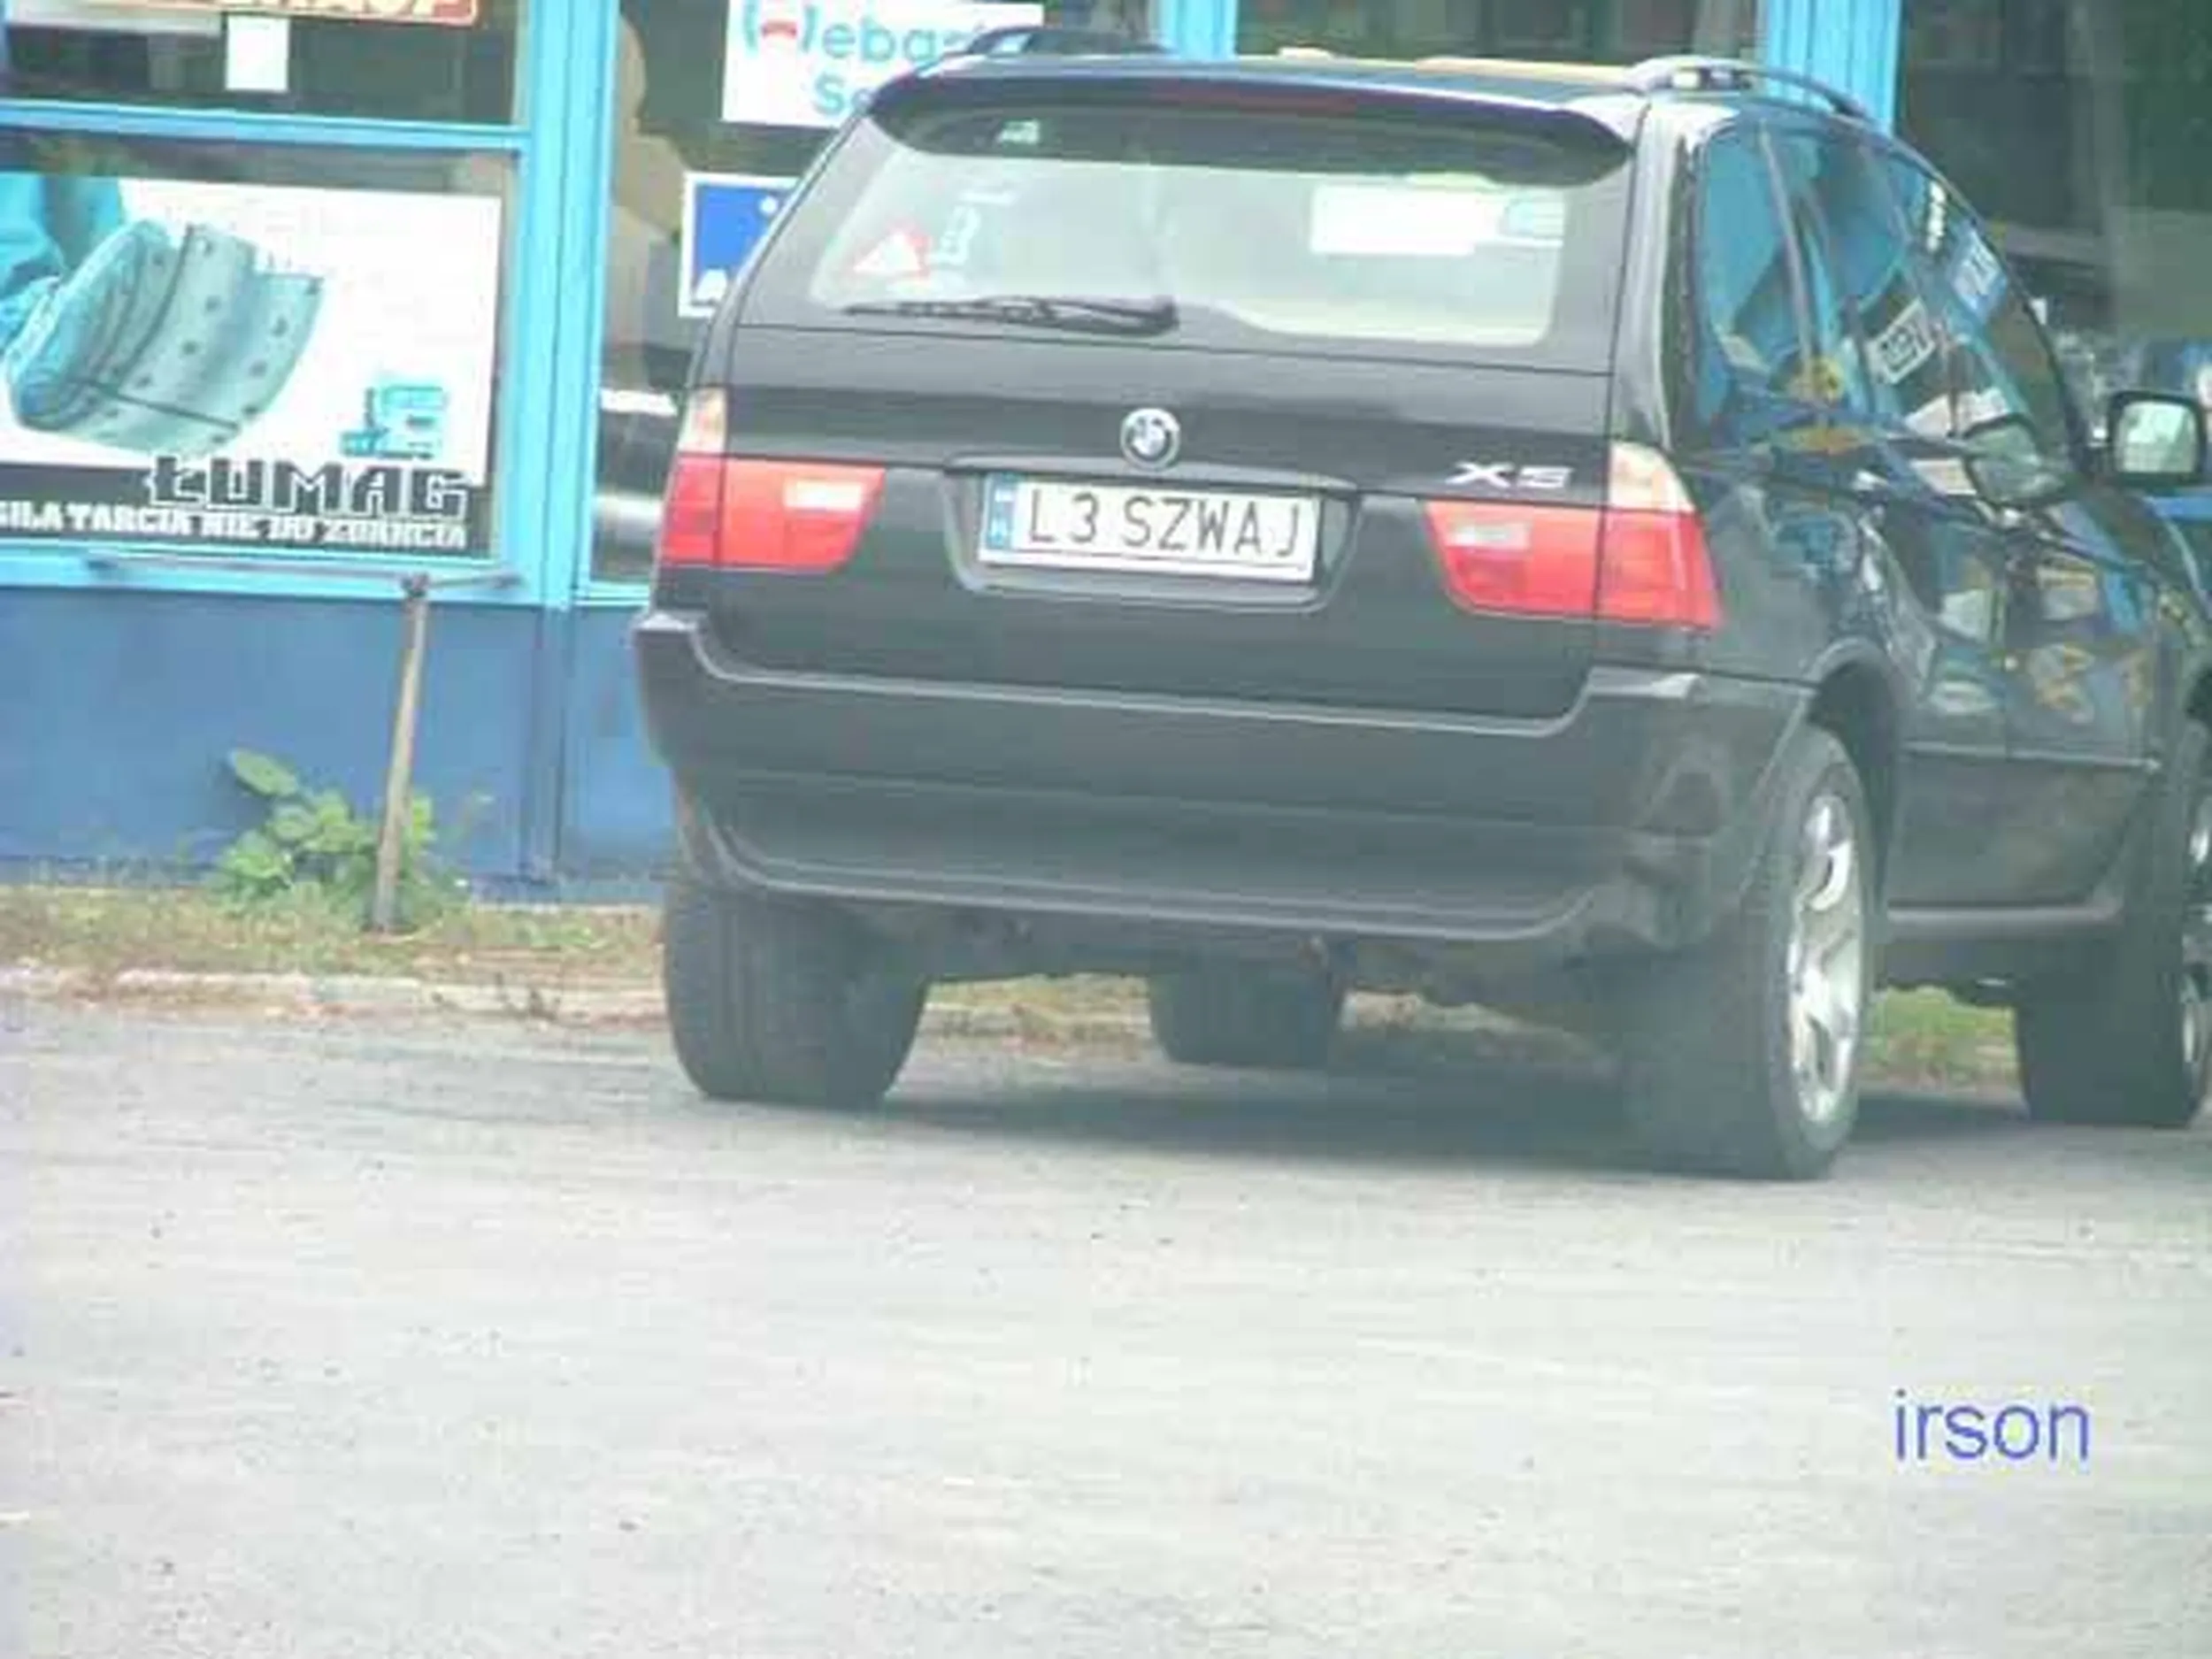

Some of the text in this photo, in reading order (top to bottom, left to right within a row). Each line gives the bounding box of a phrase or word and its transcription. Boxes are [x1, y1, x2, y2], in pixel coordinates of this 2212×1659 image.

[1445, 461, 1574, 488] X5
[1029, 488, 1300, 558] L3 SZWAJ
